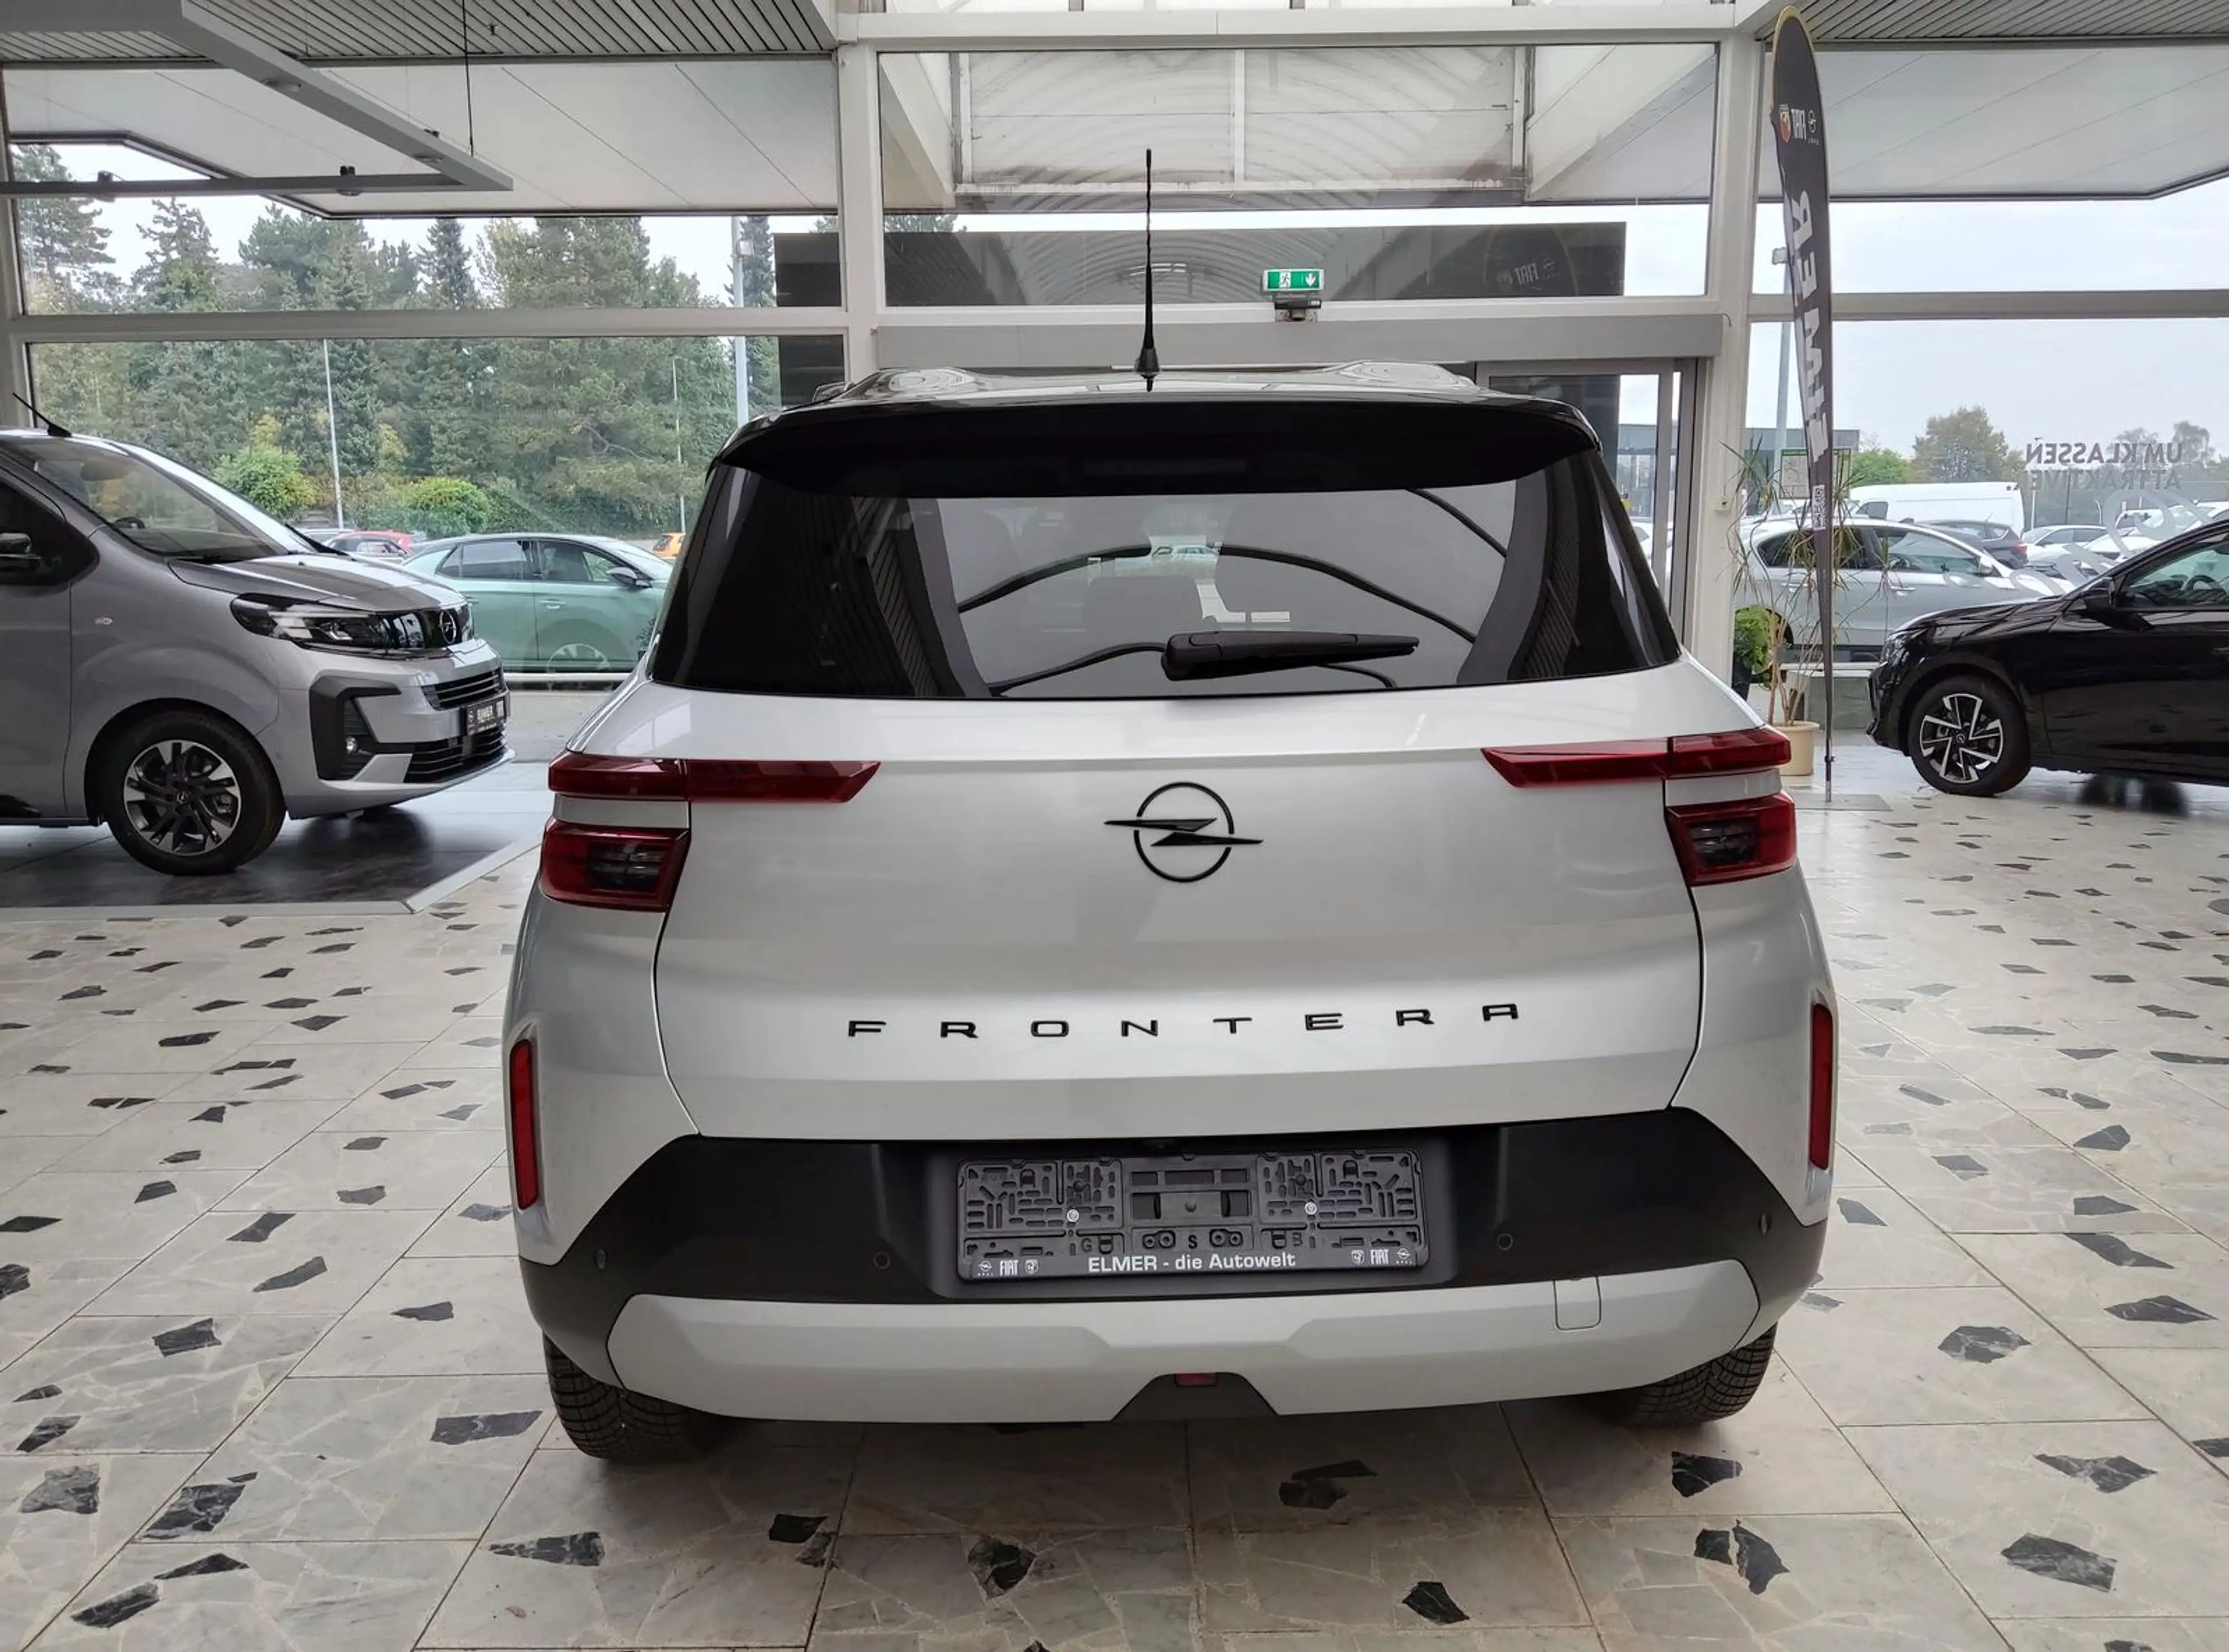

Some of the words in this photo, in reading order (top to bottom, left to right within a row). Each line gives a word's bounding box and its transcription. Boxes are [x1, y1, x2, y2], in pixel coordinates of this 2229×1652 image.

[847, 1003, 1520, 1039] FRONTERA
[1188, 1234, 1198, 1250] S
[1088, 1256, 1157, 1272] ELMER
[1175, 1253, 1203, 1270] die
[1209, 1251, 1297, 1269] Autowelt
[1370, 1249, 1389, 1265] FIAT
[1000, 1259, 1019, 1276] FIAT
